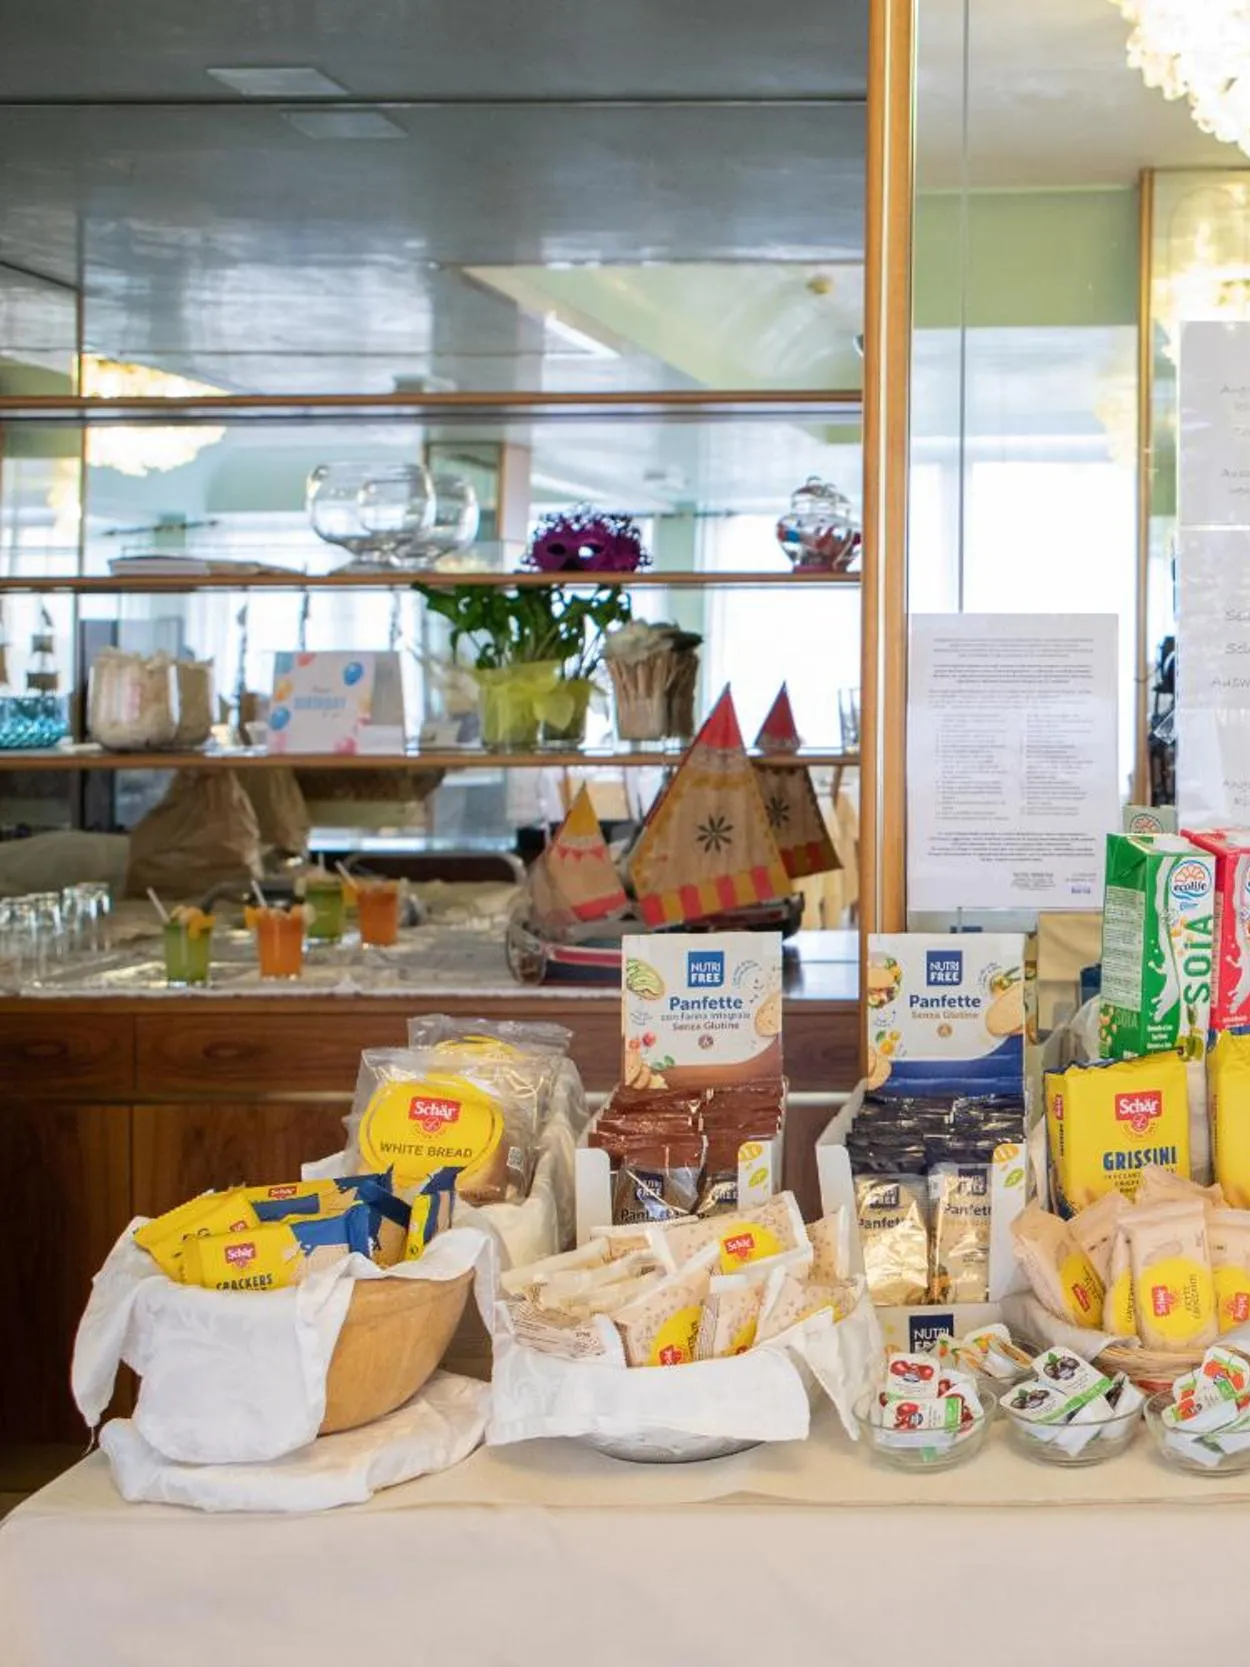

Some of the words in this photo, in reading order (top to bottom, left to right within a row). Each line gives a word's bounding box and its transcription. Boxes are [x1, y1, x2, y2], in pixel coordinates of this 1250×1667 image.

[1174, 880, 1207, 891] ecolife
[691, 961, 721, 972] NUTRI
[929, 961, 960, 971] NUTRI
[691, 973, 721, 984] FREE
[929, 972, 960, 982] FREE
[669, 996, 743, 1011] Panfette
[909, 995, 981, 1008] Panfette
[912, 1010, 941, 1019] Senza
[943, 1010, 979, 1019] Glutine
[673, 1021, 701, 1031] Senza
[704, 1020, 739, 1030] Glutine
[414, 1101, 456, 1119] Schär
[1120, 1097, 1159, 1114] Schär
[380, 1141, 424, 1157] WHITE
[427, 1147, 473, 1158] BREAD
[1103, 1146, 1177, 1171] GRISSINI
[216, 1273, 273, 1291] CRACKERS
[914, 1326, 949, 1341] NUTRI
